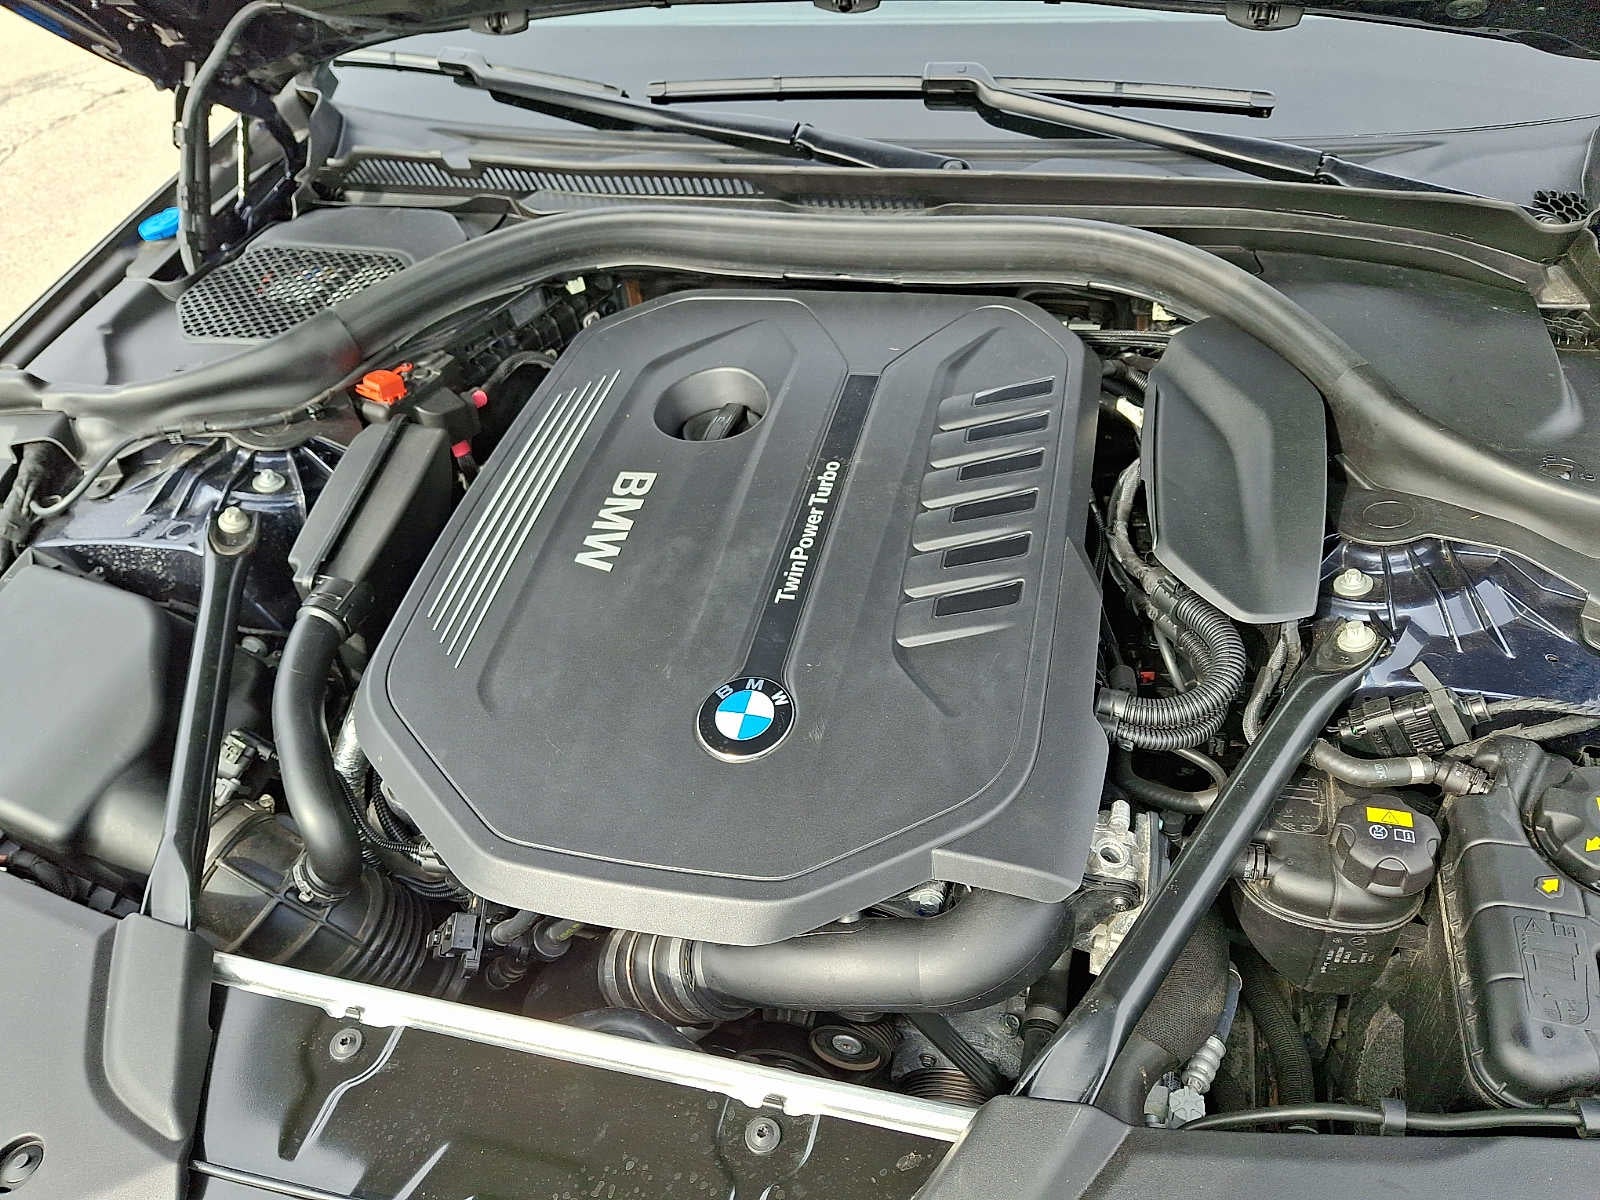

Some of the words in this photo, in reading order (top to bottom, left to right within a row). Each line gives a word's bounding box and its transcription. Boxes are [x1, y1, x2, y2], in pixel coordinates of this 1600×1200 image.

[574, 471, 658, 573] BMW
[774, 507, 825, 604] TwinPower
[808, 461, 841, 507] Turbo
[715, 679, 790, 706] BMW
